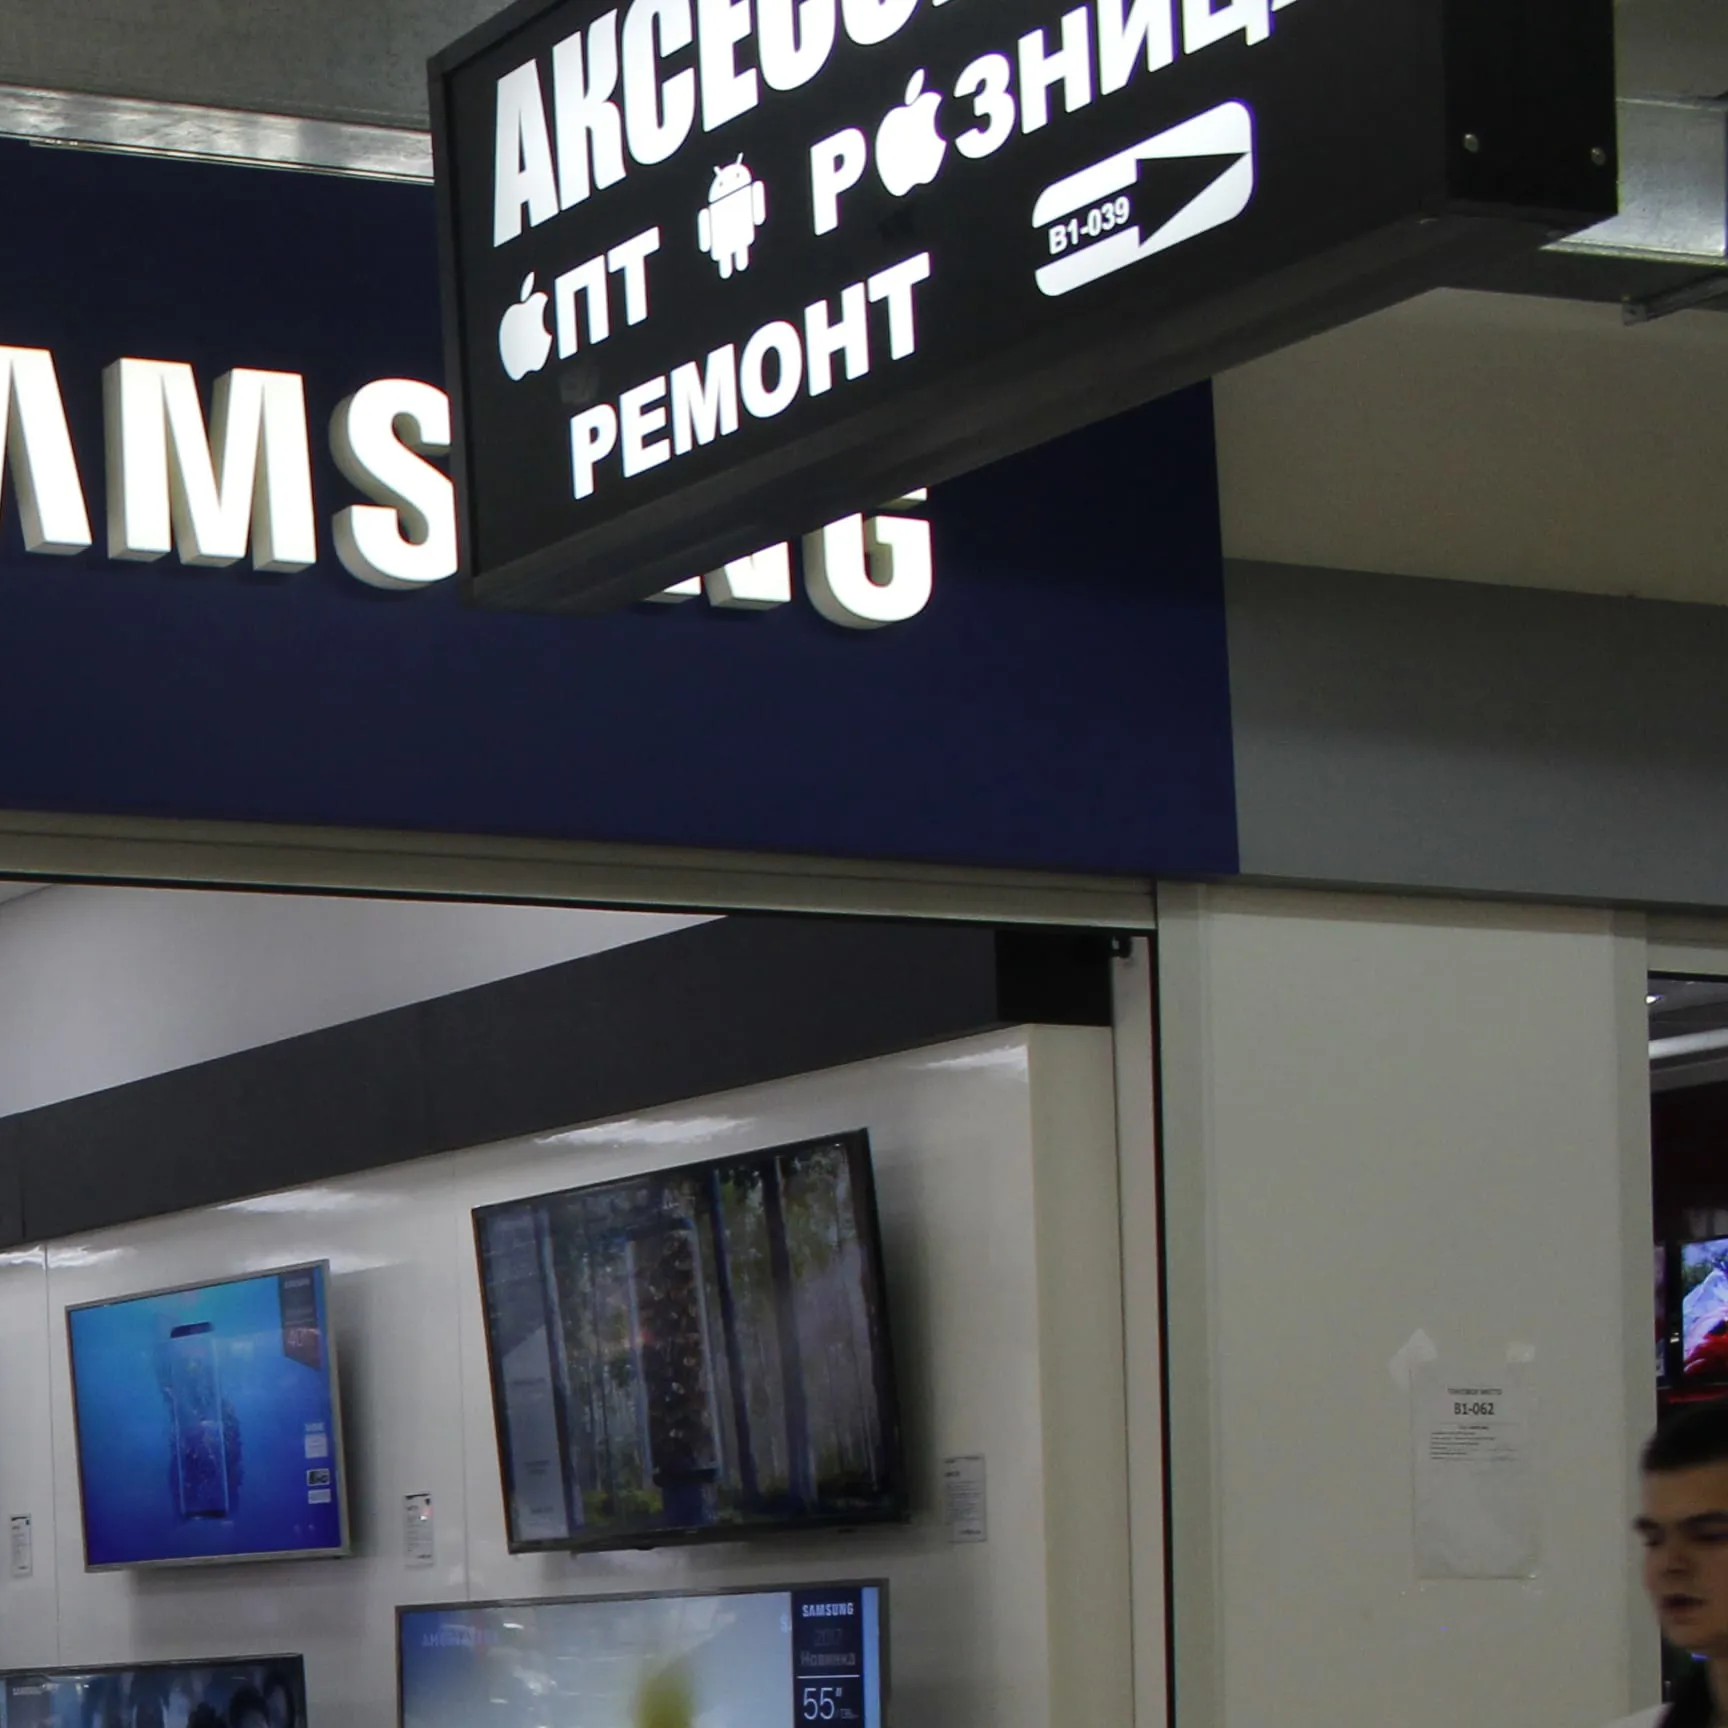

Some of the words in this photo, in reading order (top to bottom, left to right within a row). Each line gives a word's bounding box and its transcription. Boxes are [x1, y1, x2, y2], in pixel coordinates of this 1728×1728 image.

[570, 252, 931, 500] РЕМОНТ
[802, 1603, 854, 1617] SAMSUNG
[800, 1652, 856, 1667] Новинка
[803, 1687, 842, 1720] 55"
